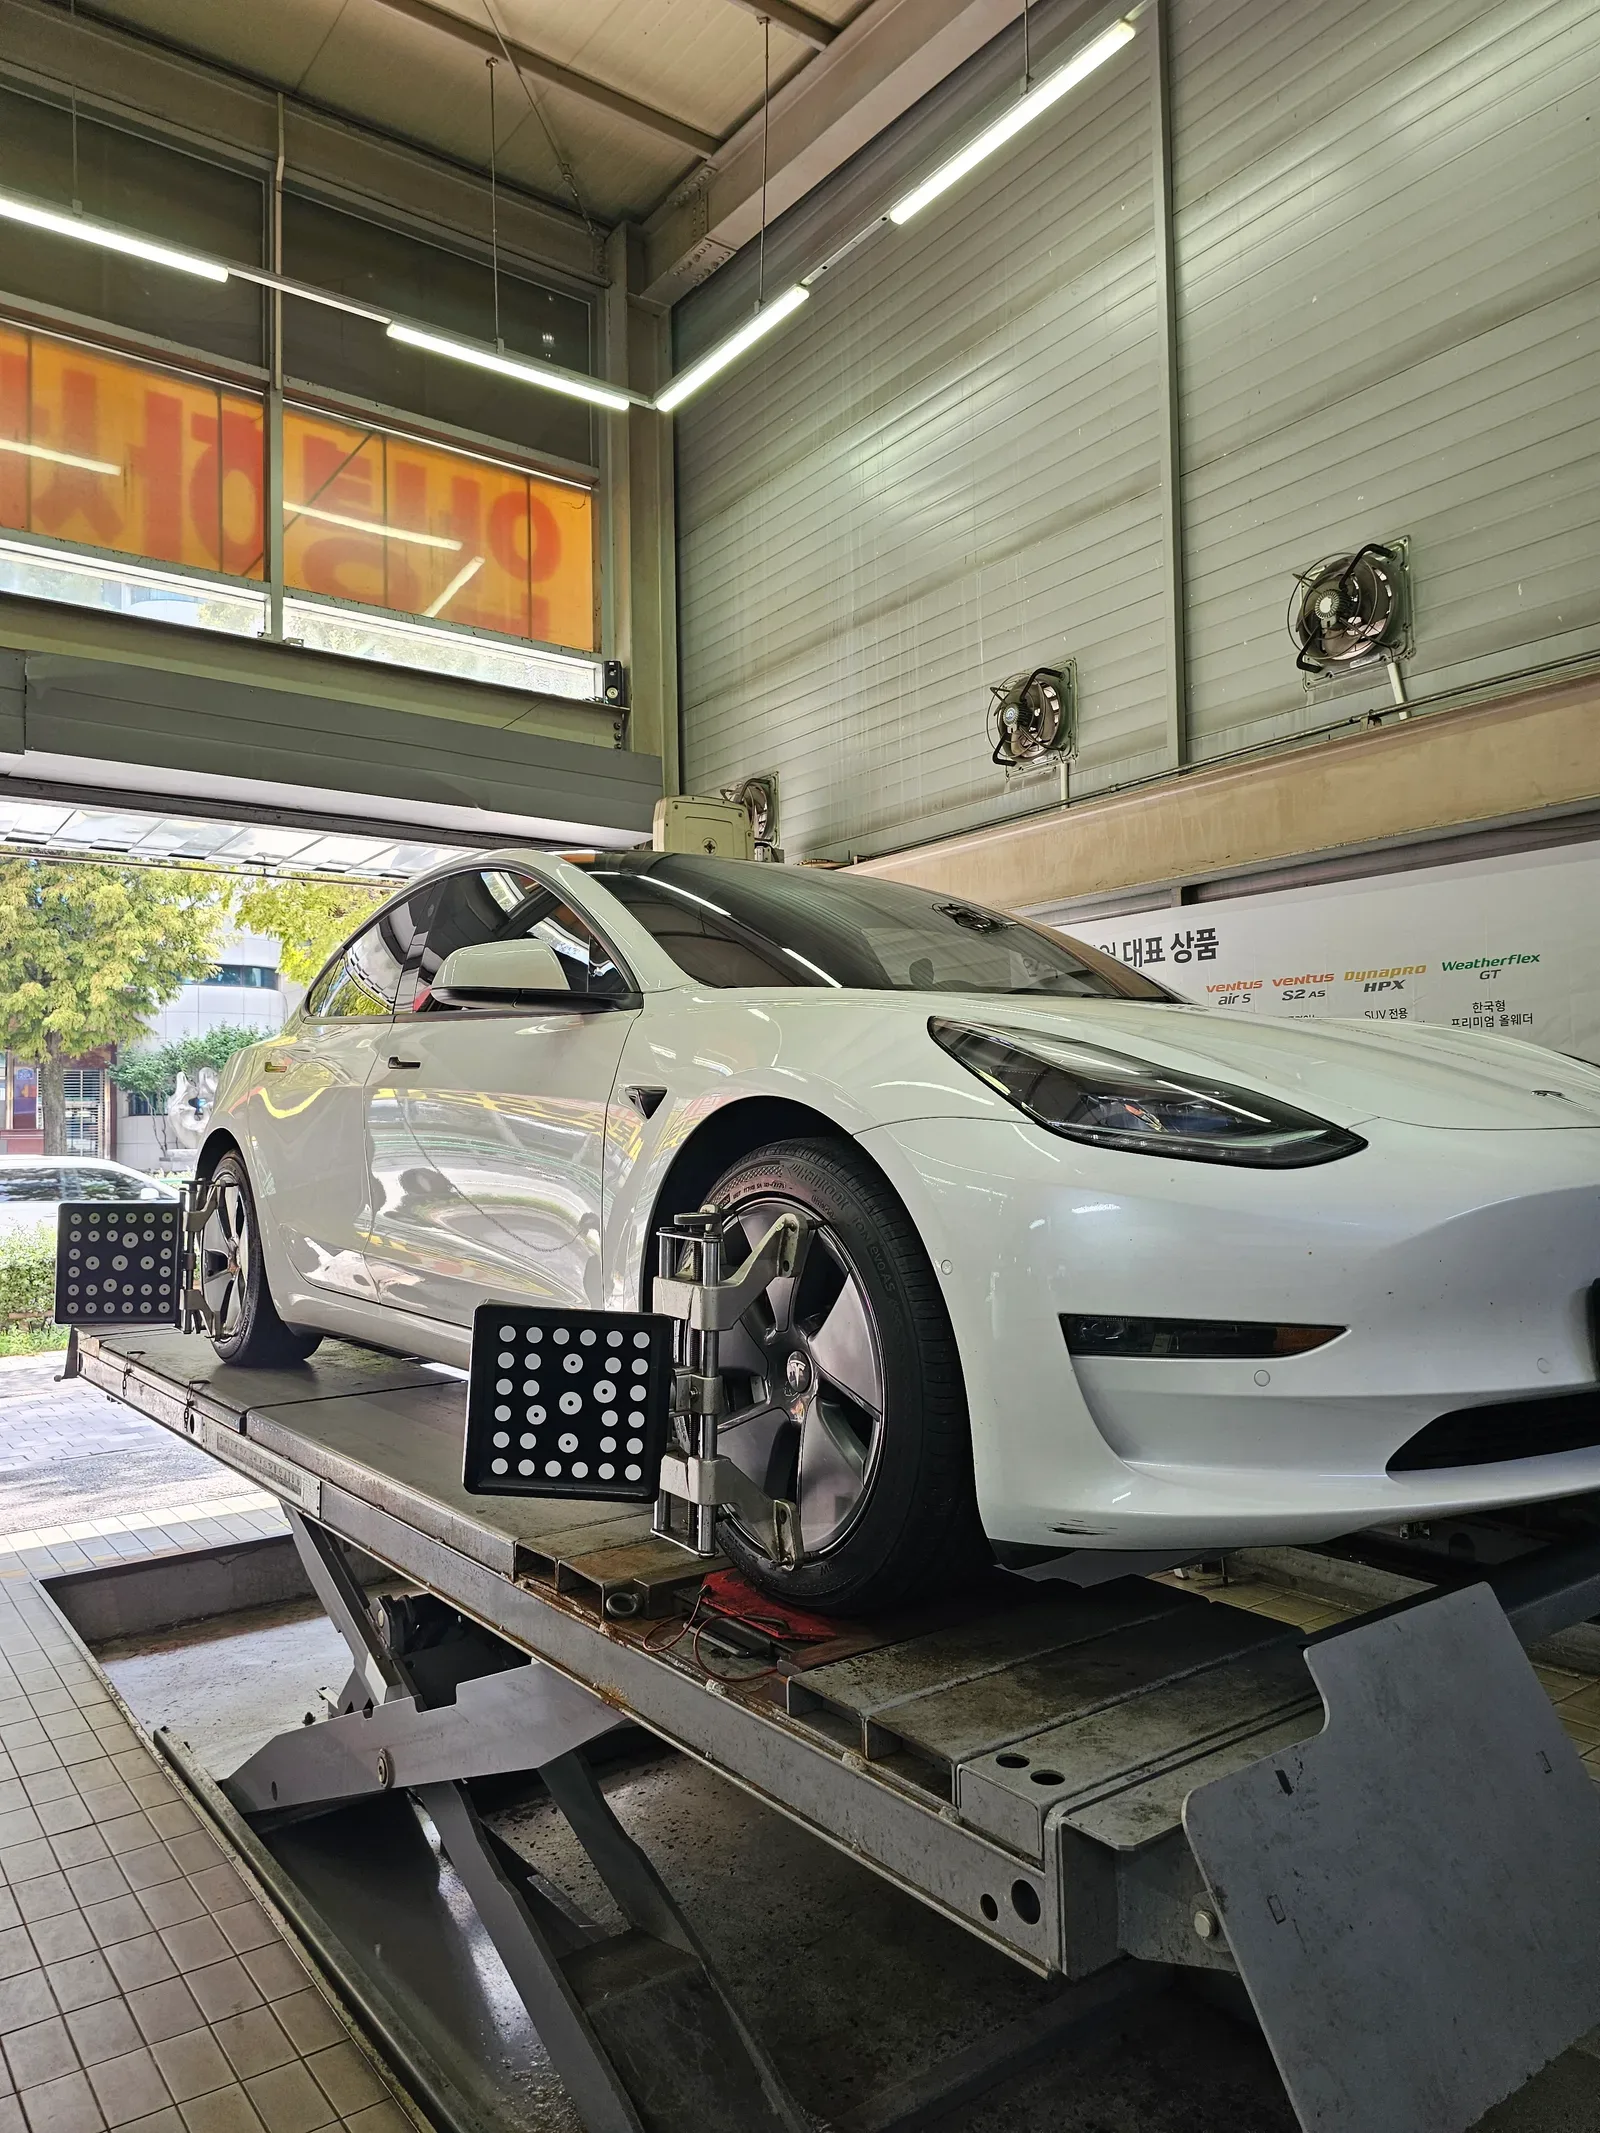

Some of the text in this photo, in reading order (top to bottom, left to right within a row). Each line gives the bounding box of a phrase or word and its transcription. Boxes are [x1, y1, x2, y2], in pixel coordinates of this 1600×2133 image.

[1122, 936, 1166, 968] 대표
[1170, 927, 1219, 964] 상품
[1442, 953, 1541, 972] Weatherflex
[1479, 969, 1501, 980] GT
[1363, 979, 1406, 993] HPX
[1218, 993, 1252, 1005] air S
[1281, 989, 1326, 1001] S2 AS
[1364, 1007, 1409, 1020] SUV 전용
[1472, 999, 1506, 1014] 한국형
[1451, 1012, 1533, 1029] 프리미엄 올웨더
